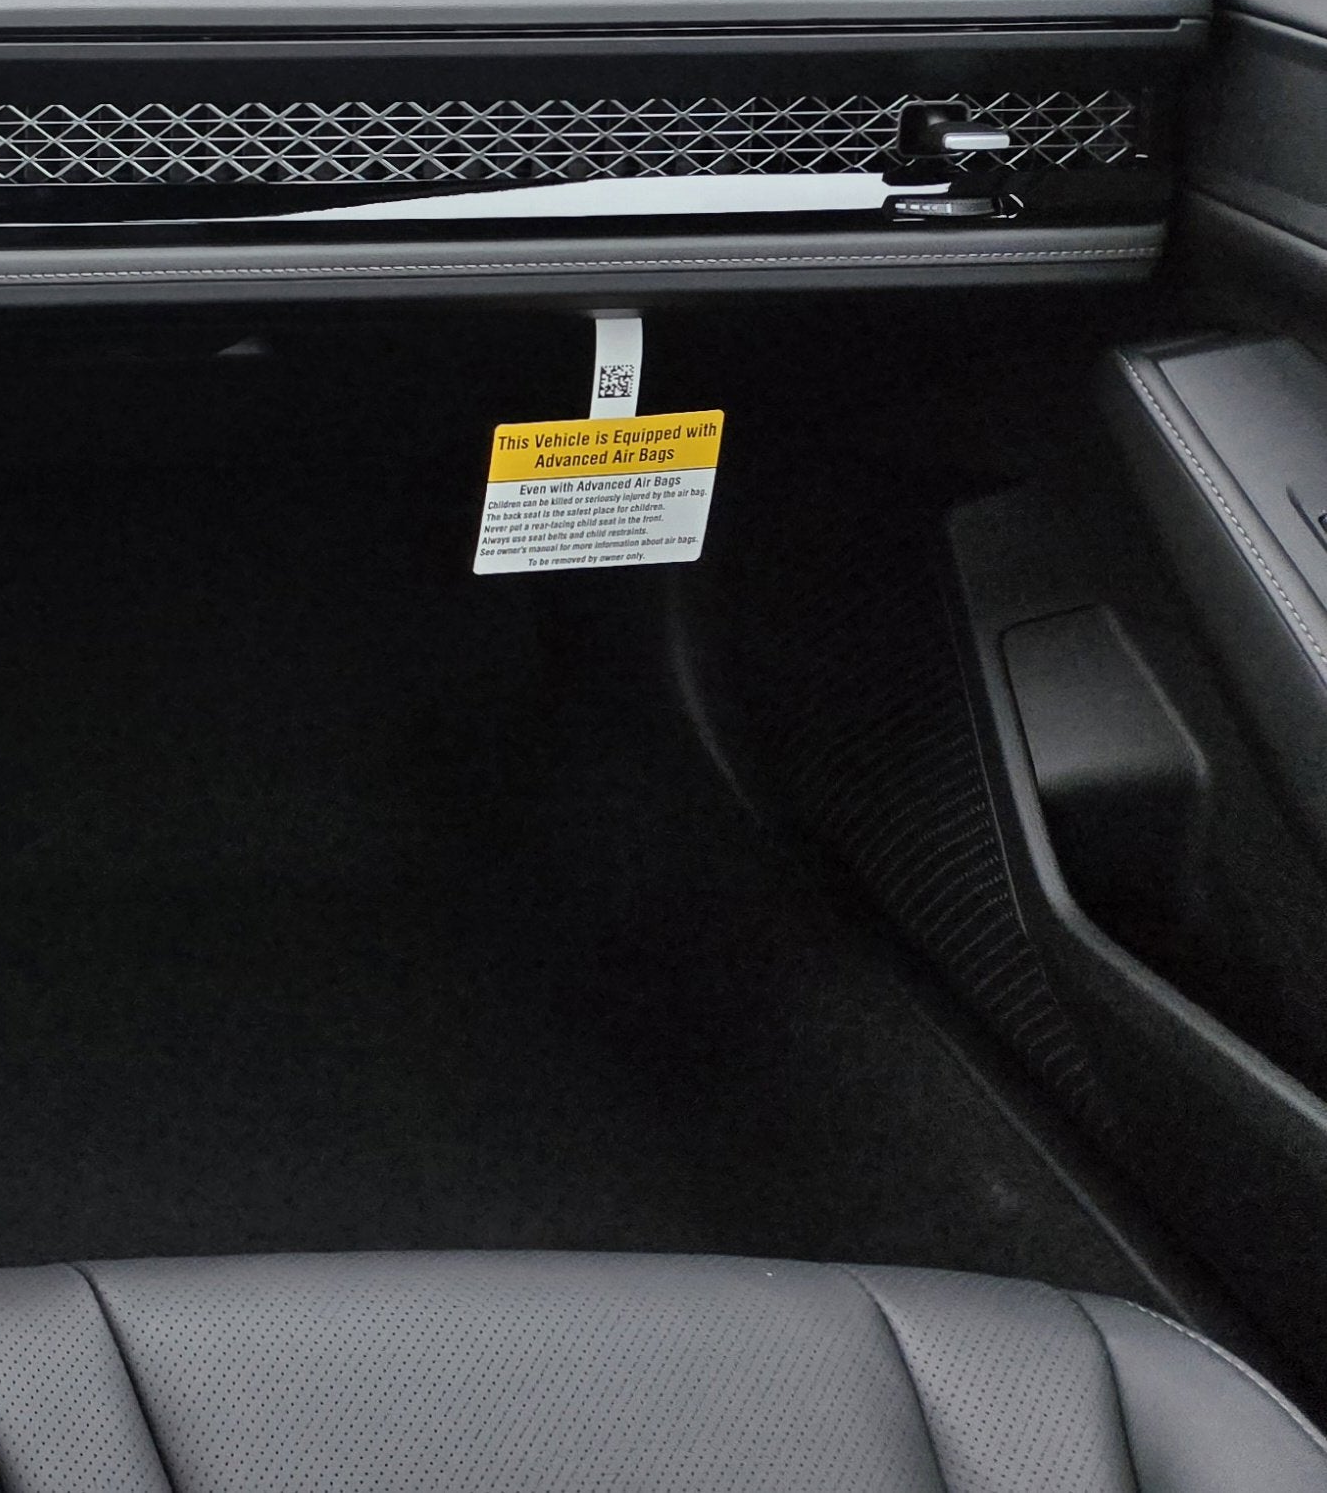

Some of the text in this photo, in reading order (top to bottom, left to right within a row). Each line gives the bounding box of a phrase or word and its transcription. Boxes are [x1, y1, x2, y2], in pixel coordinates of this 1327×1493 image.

[498, 422, 717, 451] This Vehicle is Equipped with
[534, 448, 675, 469] Advanced Air Bags
[519, 475, 682, 496] Even with Advanced Air Bags
[488, 500, 521, 510] Children
[539, 498, 550, 507] be
[551, 496, 573, 506] killed
[575, 497, 583, 505] or
[585, 493, 621, 504] seriously
[622, 491, 651, 502] injured
[652, 490, 662, 501] by
[663, 489, 676, 498] the
[677, 489, 689, 498] air
[690, 487, 707, 498] bag.
[487, 513, 501, 522] The
[503, 511, 522, 521] back
[523, 510, 541, 519] seat
[542, 509, 551, 518] is
[552, 508, 565, 517] the
[566, 507, 592, 517] safest
[593, 505, 615, 517] place
[616, 505, 629, 514] for
[484, 525, 508, 533] Never
[509, 523, 523, 534] put
[576, 518, 597, 527] child
[598, 517, 617, 526] seat
[617, 516, 626, 525] in
[627, 515, 641, 524] the
[528, 558, 538, 567] To
[539, 557, 550, 566] be
[551, 555, 586, 565] removed
[587, 554, 598, 564] by
